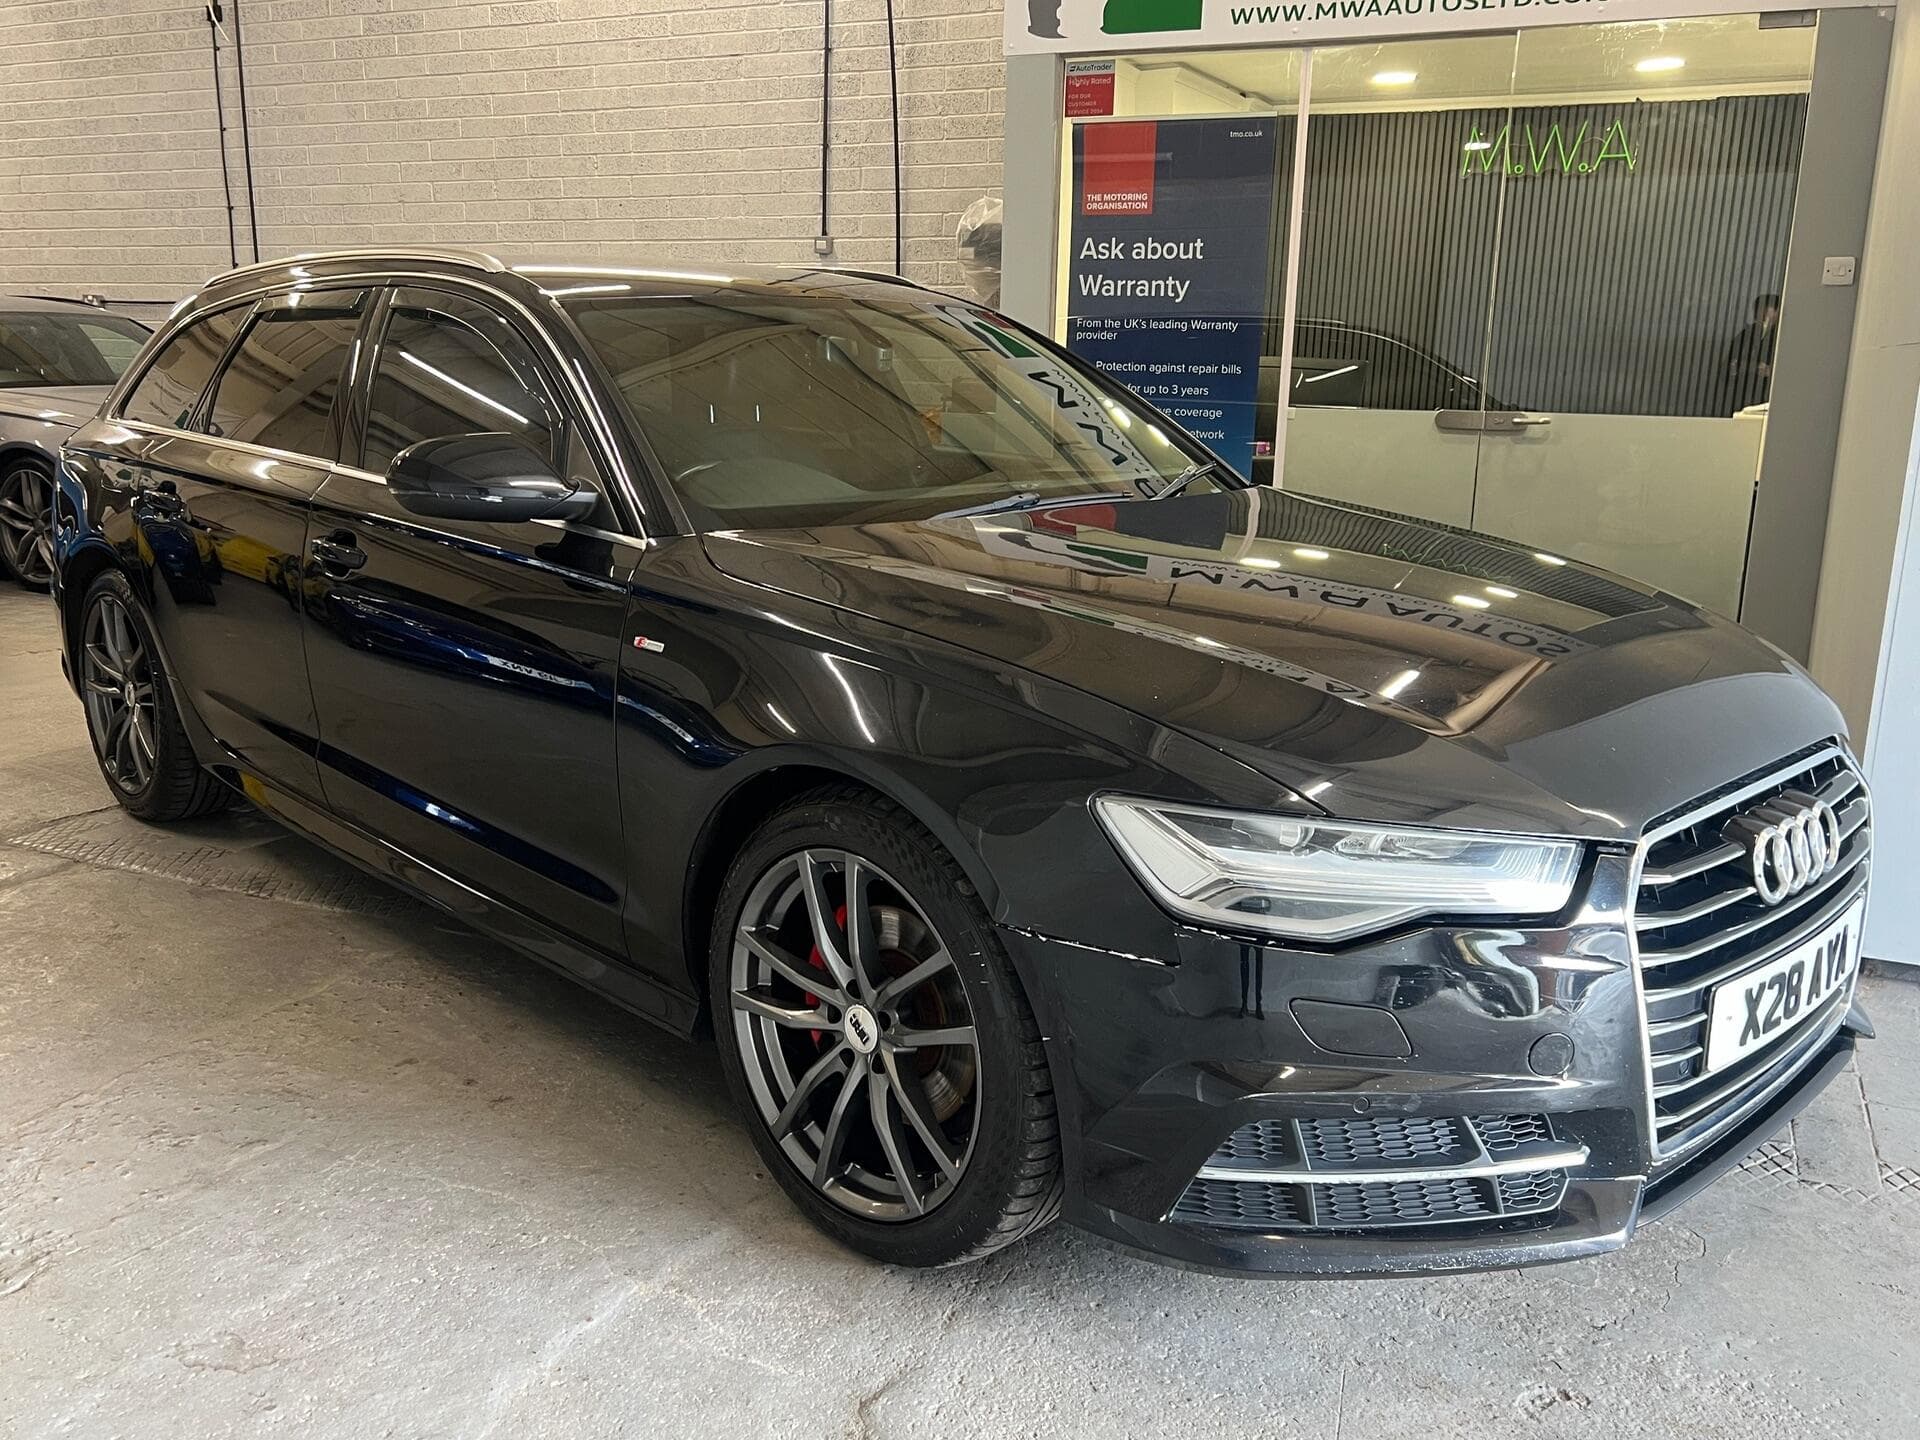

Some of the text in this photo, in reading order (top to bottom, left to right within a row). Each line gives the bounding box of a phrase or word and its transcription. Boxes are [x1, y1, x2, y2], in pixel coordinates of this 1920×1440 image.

[1076, 64, 1112, 72] AutoTrader
[1091, 76, 1112, 85] Rated
[1230, 130, 1264, 138] tmo.co.uk
[1103, 193, 1148, 201] MOTORING
[1086, 201, 1148, 210] ORGANISATION
[1079, 237, 1205, 260] Ask about
[1078, 274, 1191, 302] Warranty
[1076, 318, 1101, 329] From
[1104, 318, 1121, 329] the
[1149, 319, 1188, 332] leading
[1190, 320, 1239, 333] Warranty
[1076, 330, 1118, 341] provider
[1096, 361, 1242, 376] Protection against repair bills
[1127, 383, 1209, 397] for up to 3 years
[1174, 408, 1223, 420] coverage
[1190, 430, 1225, 440] etwork
[1739, 924, 1849, 1047] X28 AYA
